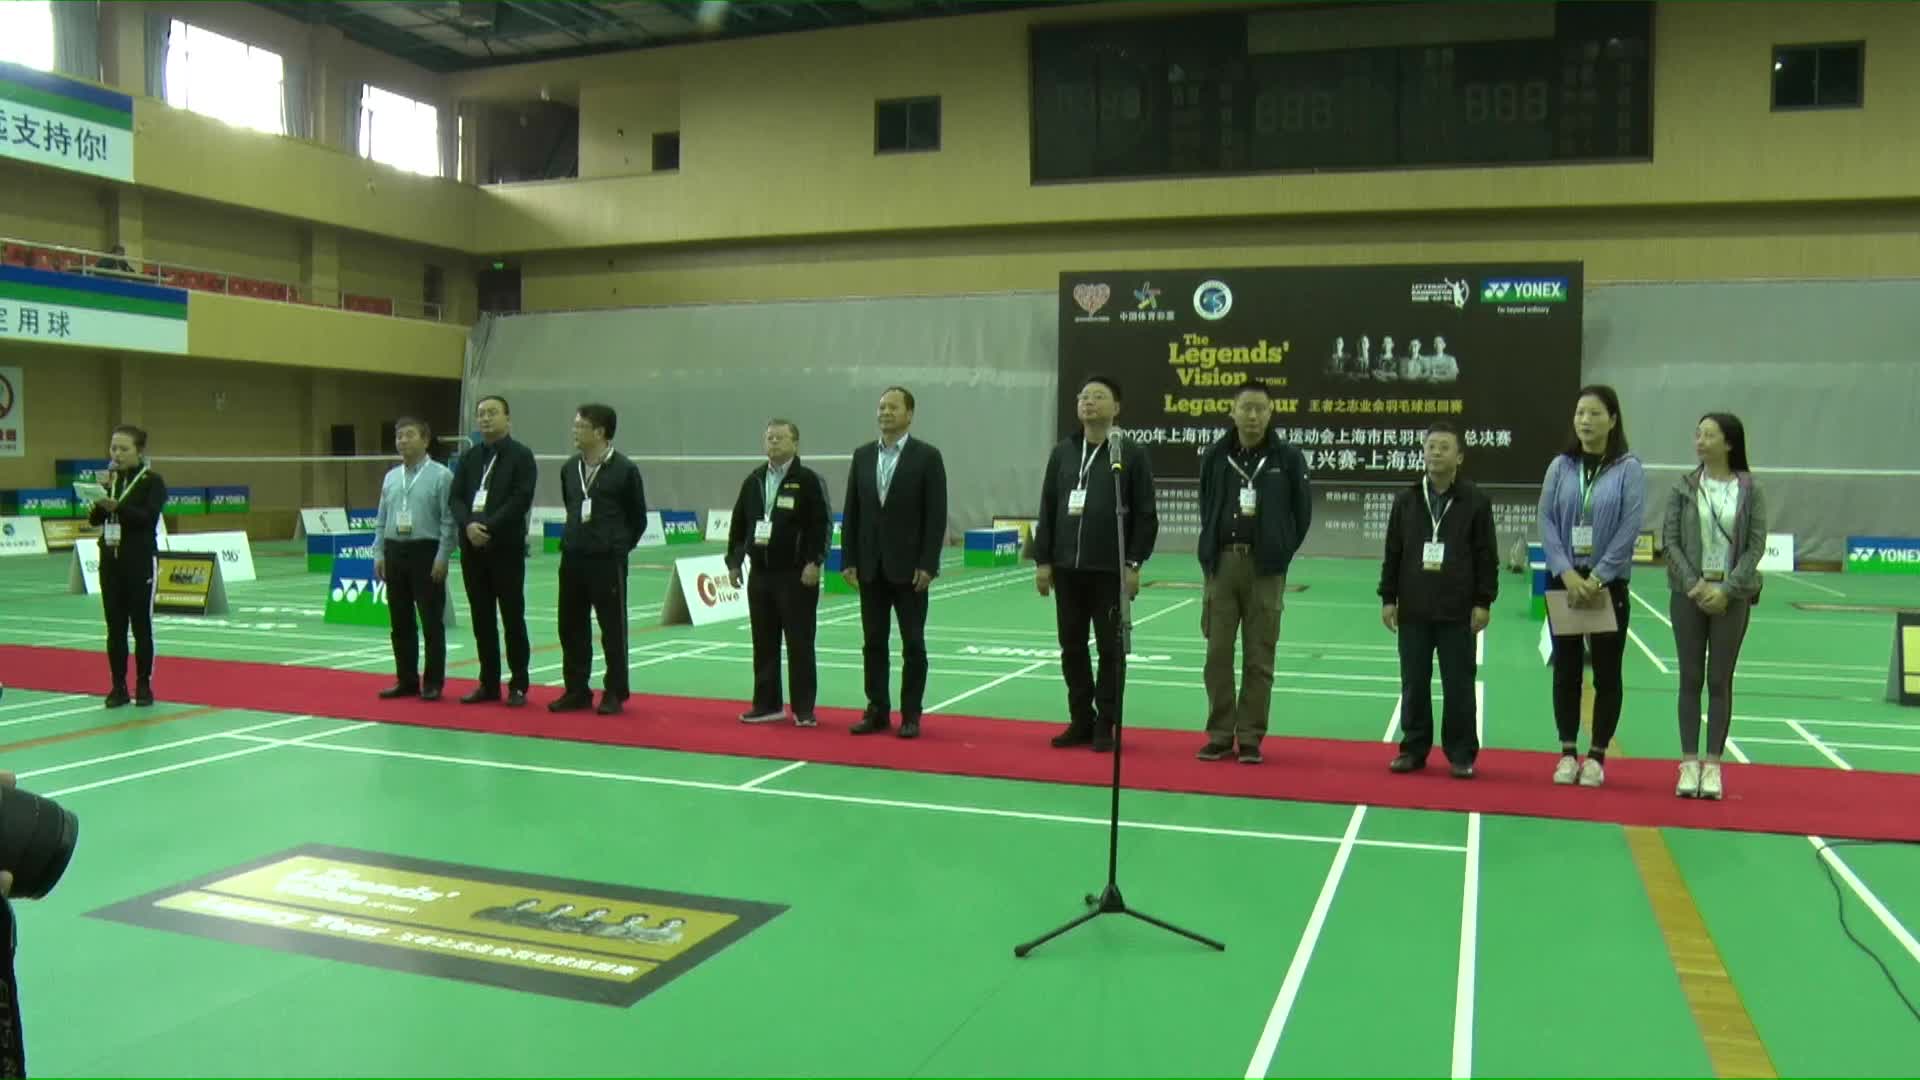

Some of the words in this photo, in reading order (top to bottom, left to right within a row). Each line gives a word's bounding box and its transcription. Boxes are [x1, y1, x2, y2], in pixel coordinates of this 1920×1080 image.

[0, 110, 107, 161] 支持你!
[1513, 281, 1561, 298] YONEX
[1183, 333, 1209, 345] The
[1168, 340, 1290, 368] Legends'
[1176, 367, 1248, 386] Vision
[718, 591, 741, 603] live
